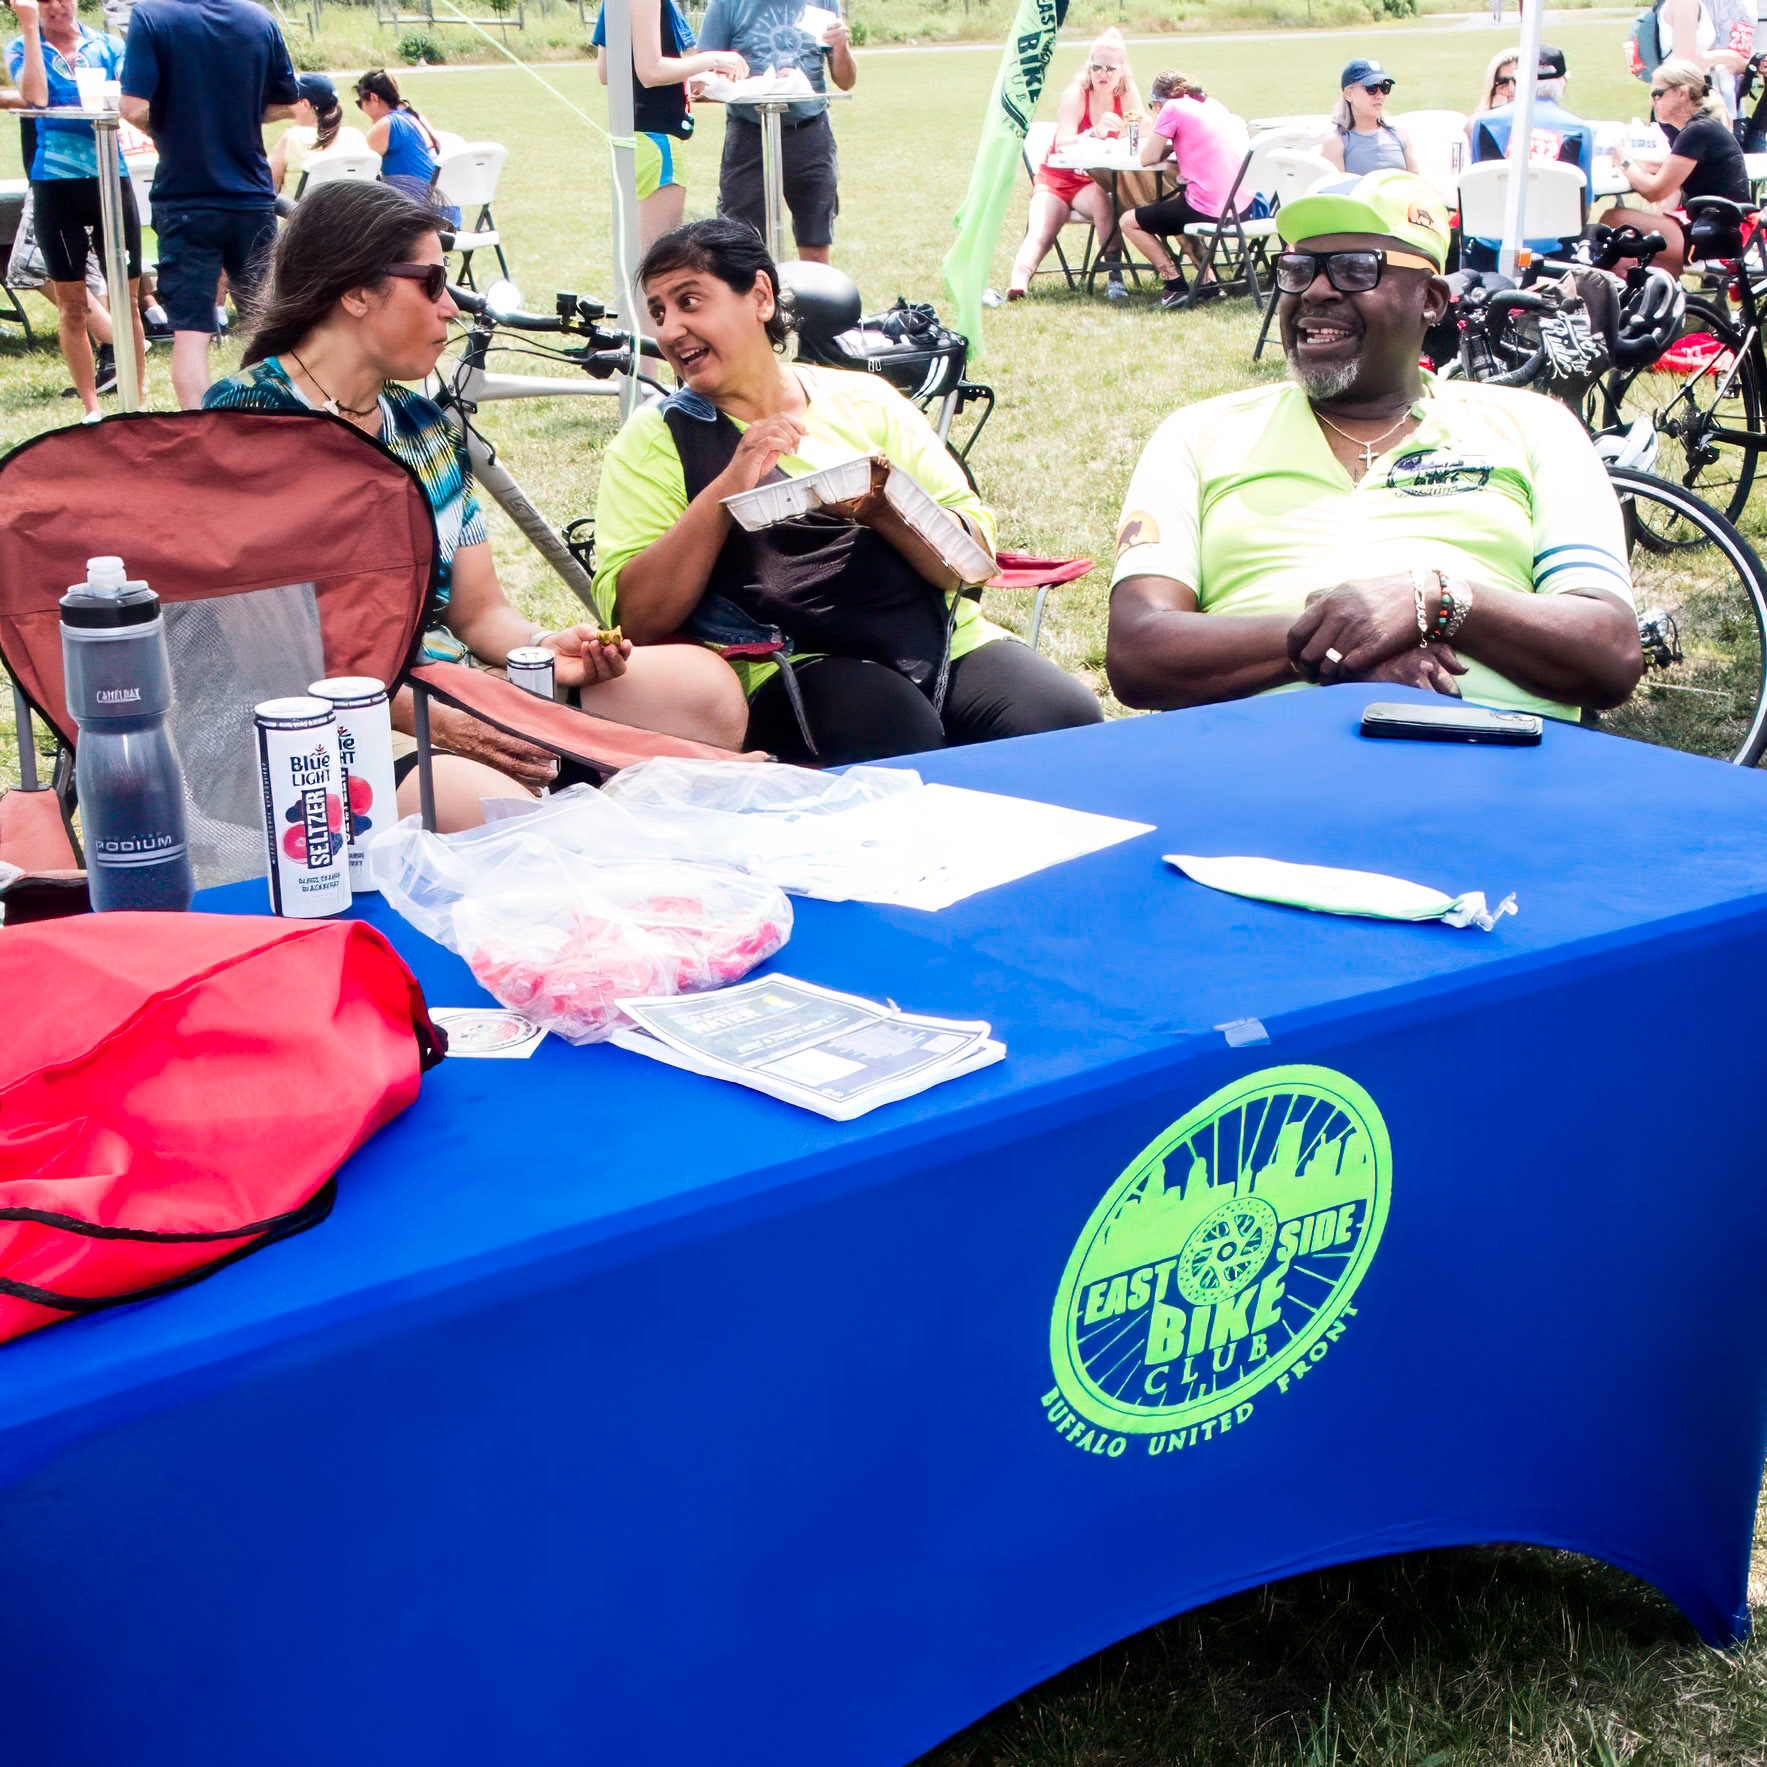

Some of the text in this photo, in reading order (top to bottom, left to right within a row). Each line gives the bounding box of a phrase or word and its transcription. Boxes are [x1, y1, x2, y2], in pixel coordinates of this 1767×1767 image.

[290, 753, 330, 772] Blue
[292, 769, 330, 787] LIGHT
[95, 834, 172, 851] PODIUM
[304, 788, 331, 867] SELTZER
[1084, 1203, 1356, 1326] EAST SIDE
[1144, 1262, 1288, 1365] BIKE
[1040, 1301, 1359, 1458] BUFFALO UNITED FRONT
[1143, 1332, 1270, 1395] CLUB
